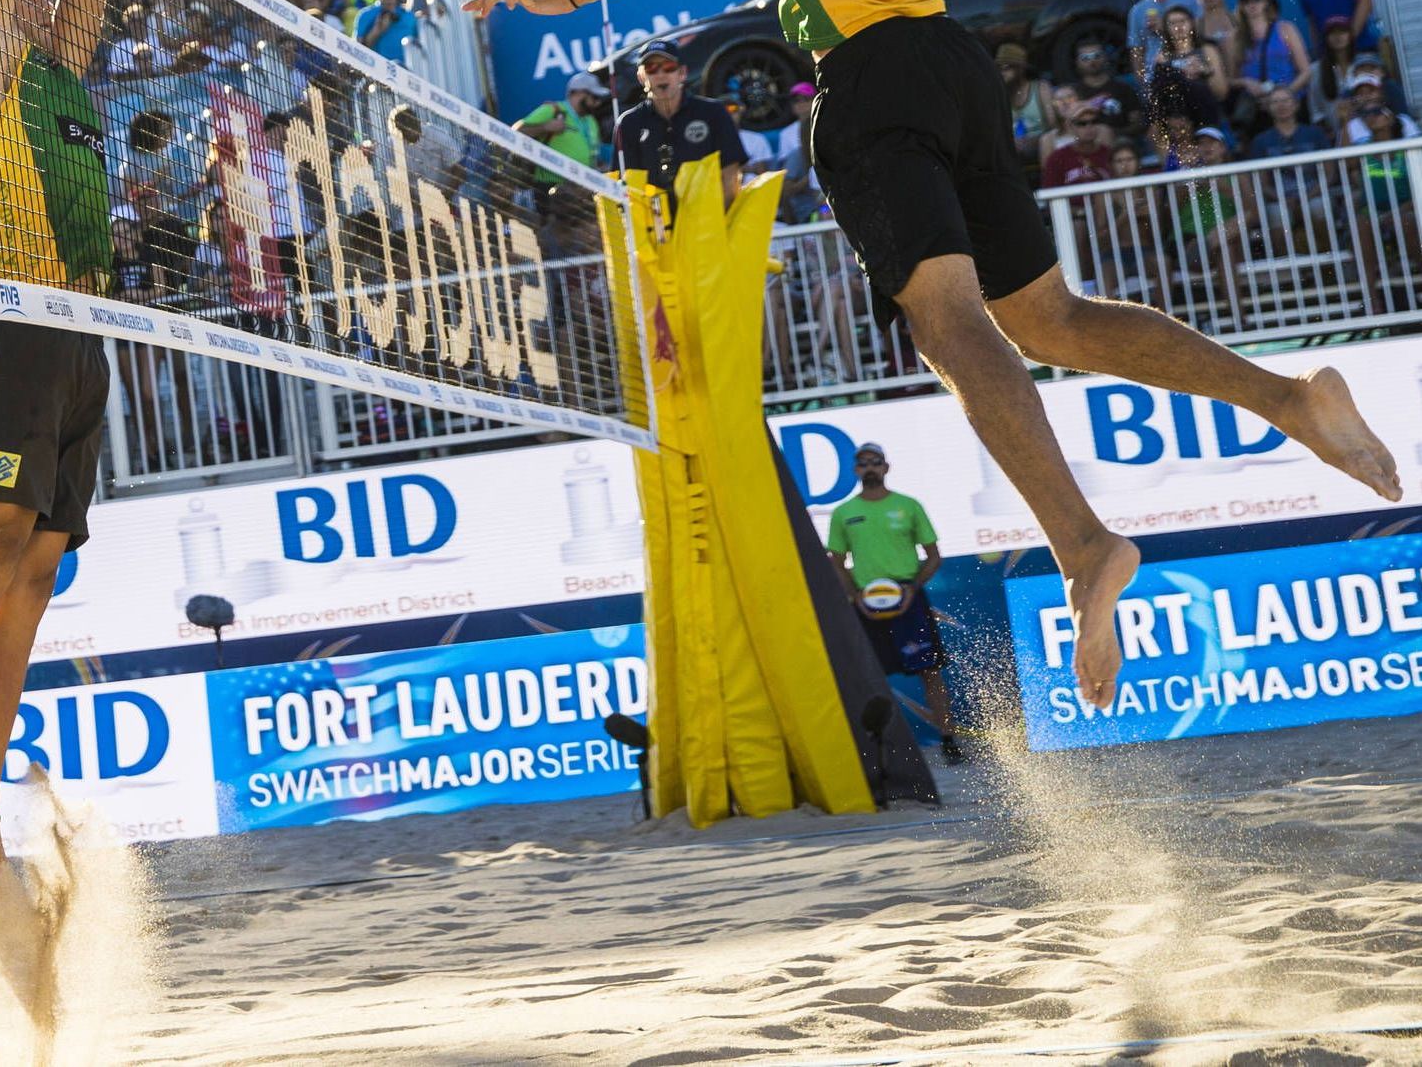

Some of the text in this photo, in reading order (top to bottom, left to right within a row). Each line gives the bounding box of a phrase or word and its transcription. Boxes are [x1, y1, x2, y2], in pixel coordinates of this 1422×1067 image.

[0, 284, 21, 307] FIVB
[275, 474, 457, 564] BID
[977, 526, 1047, 546] Beac
[1227, 493, 1321, 519] District
[251, 600, 390, 628] Improvement
[398, 589, 477, 613] District
[564, 571, 637, 595] Beach
[1038, 591, 1193, 669] FRT
[1, 690, 170, 784] BID
[244, 684, 377, 756] FORT
